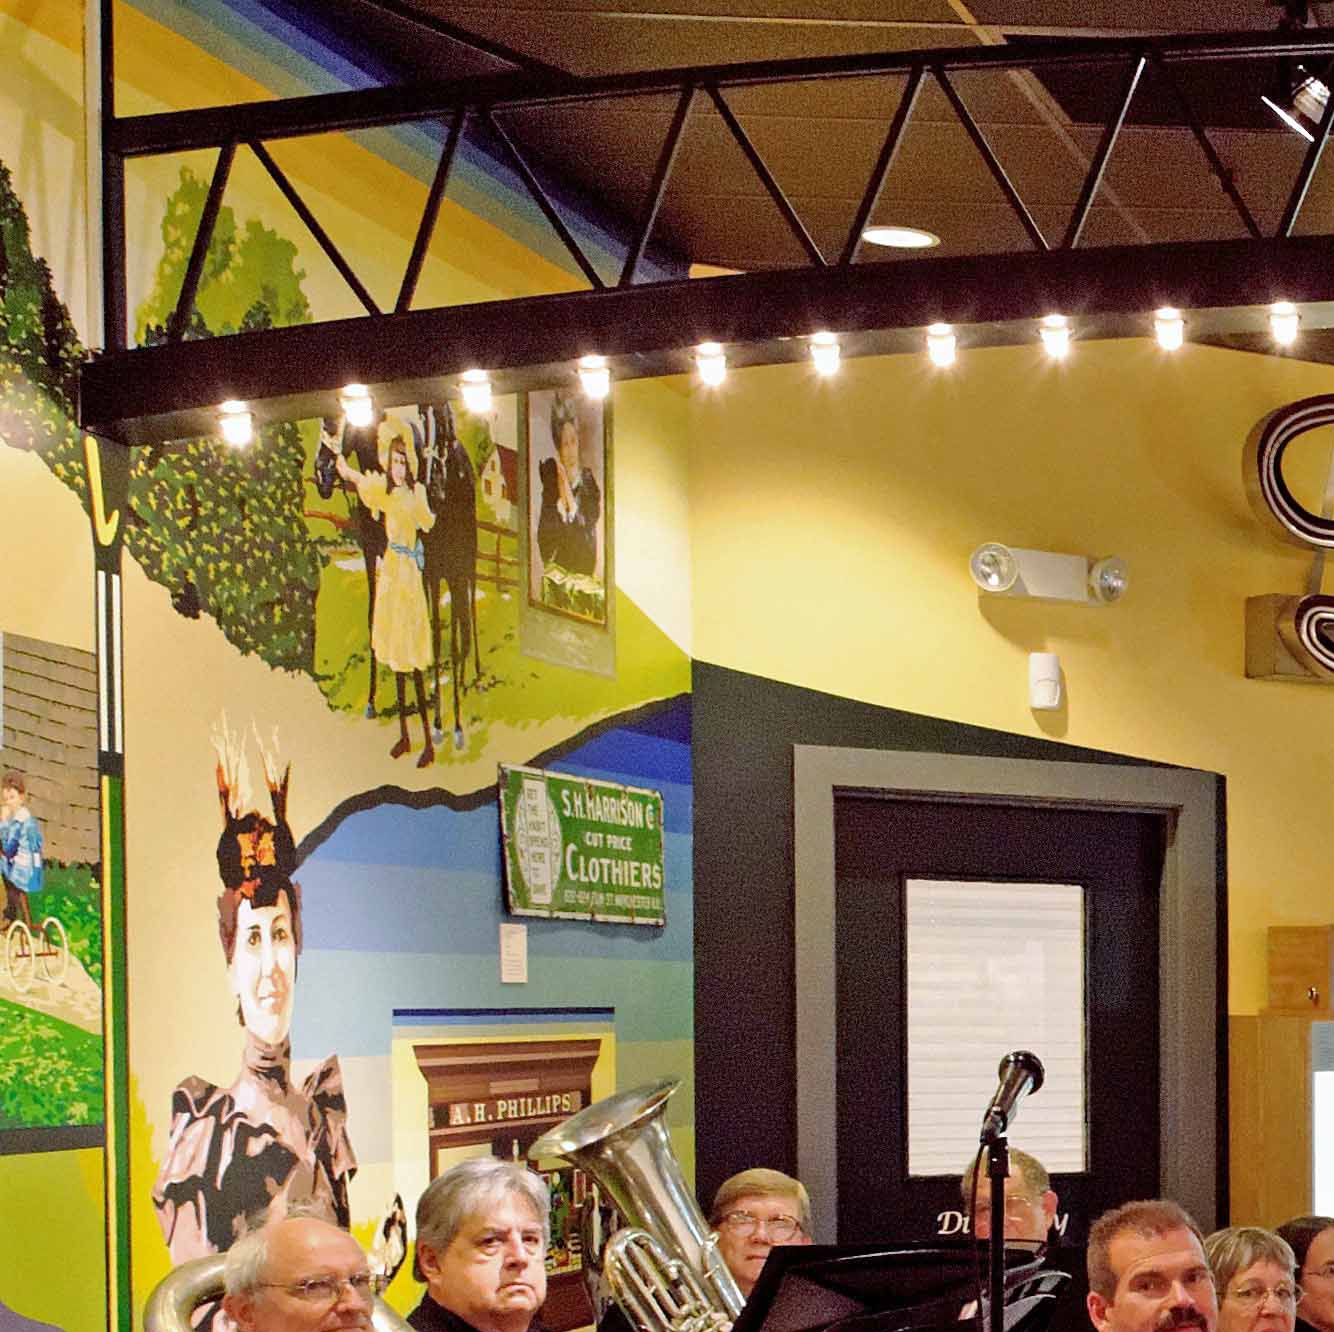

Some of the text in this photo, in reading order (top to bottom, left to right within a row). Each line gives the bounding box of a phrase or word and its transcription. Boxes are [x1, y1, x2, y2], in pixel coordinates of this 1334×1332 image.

[585, 831, 633, 851] CUT PRICE
[496, 1093, 572, 1120] PHILLIPS
